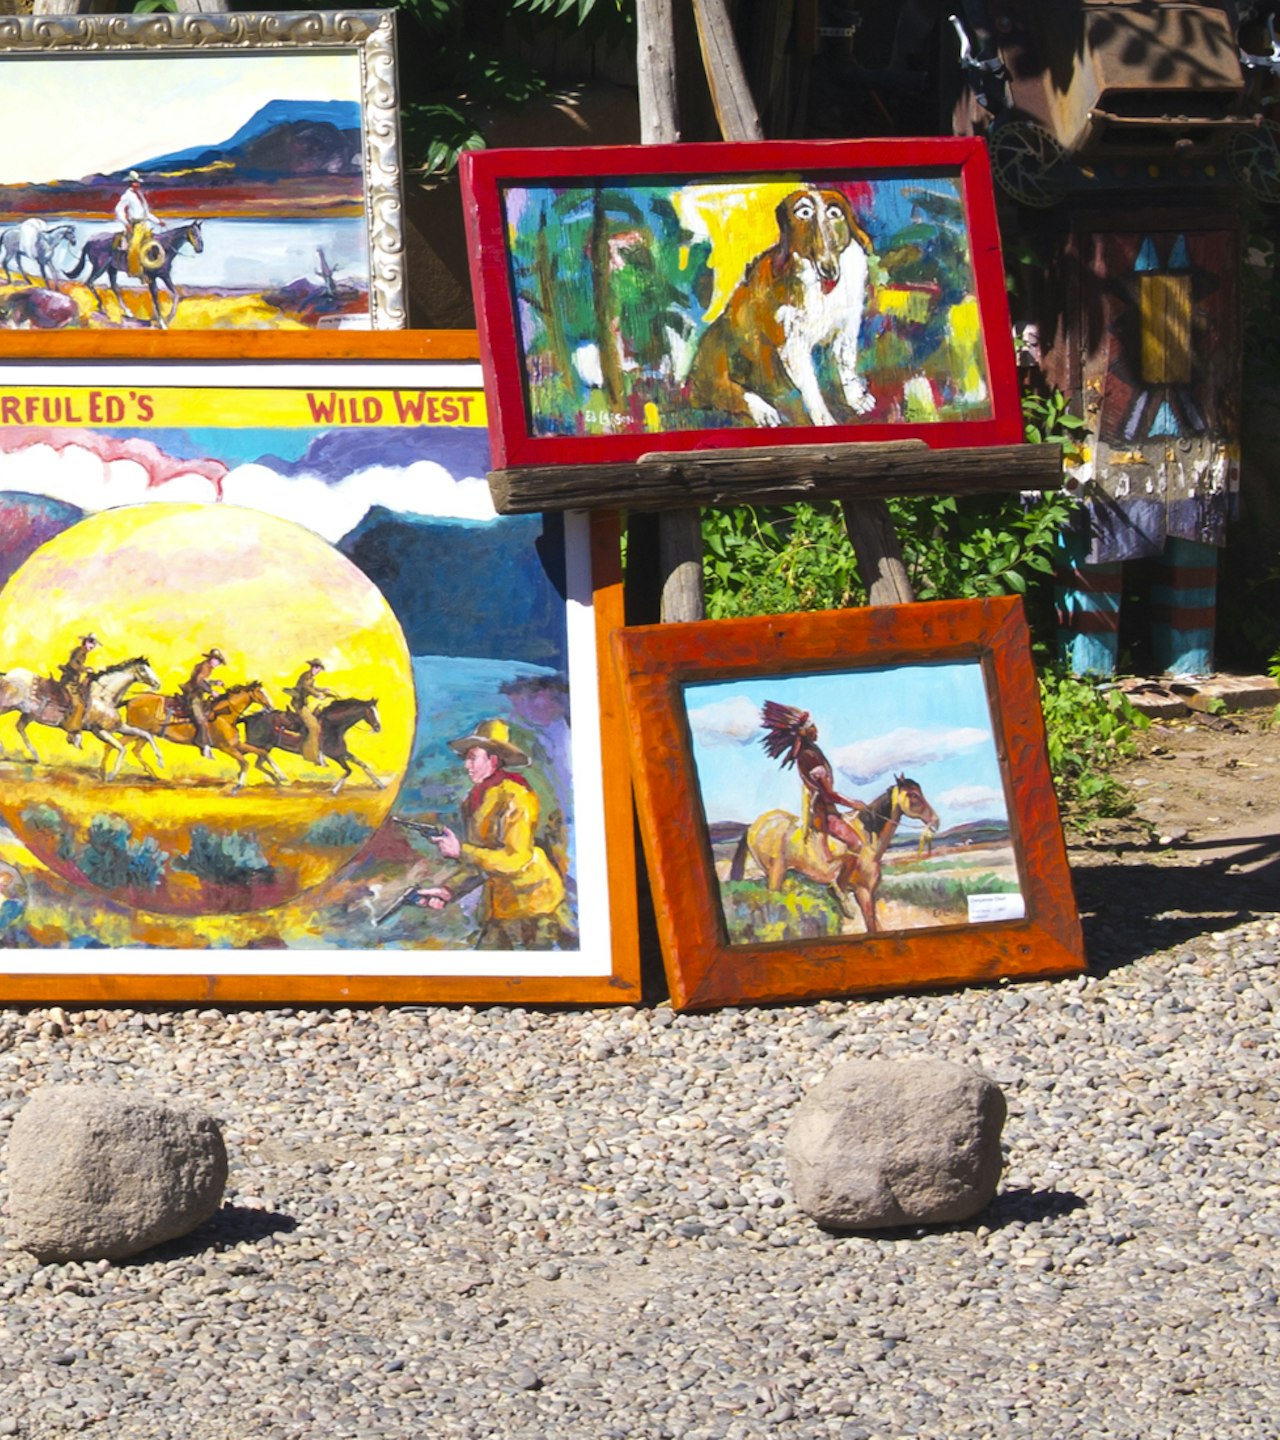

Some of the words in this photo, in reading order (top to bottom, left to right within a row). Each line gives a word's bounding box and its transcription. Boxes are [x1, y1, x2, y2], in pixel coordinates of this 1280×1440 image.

[89, 390, 154, 423] ED'S
[307, 392, 383, 423] WILD
[393, 391, 474, 424] WEST
